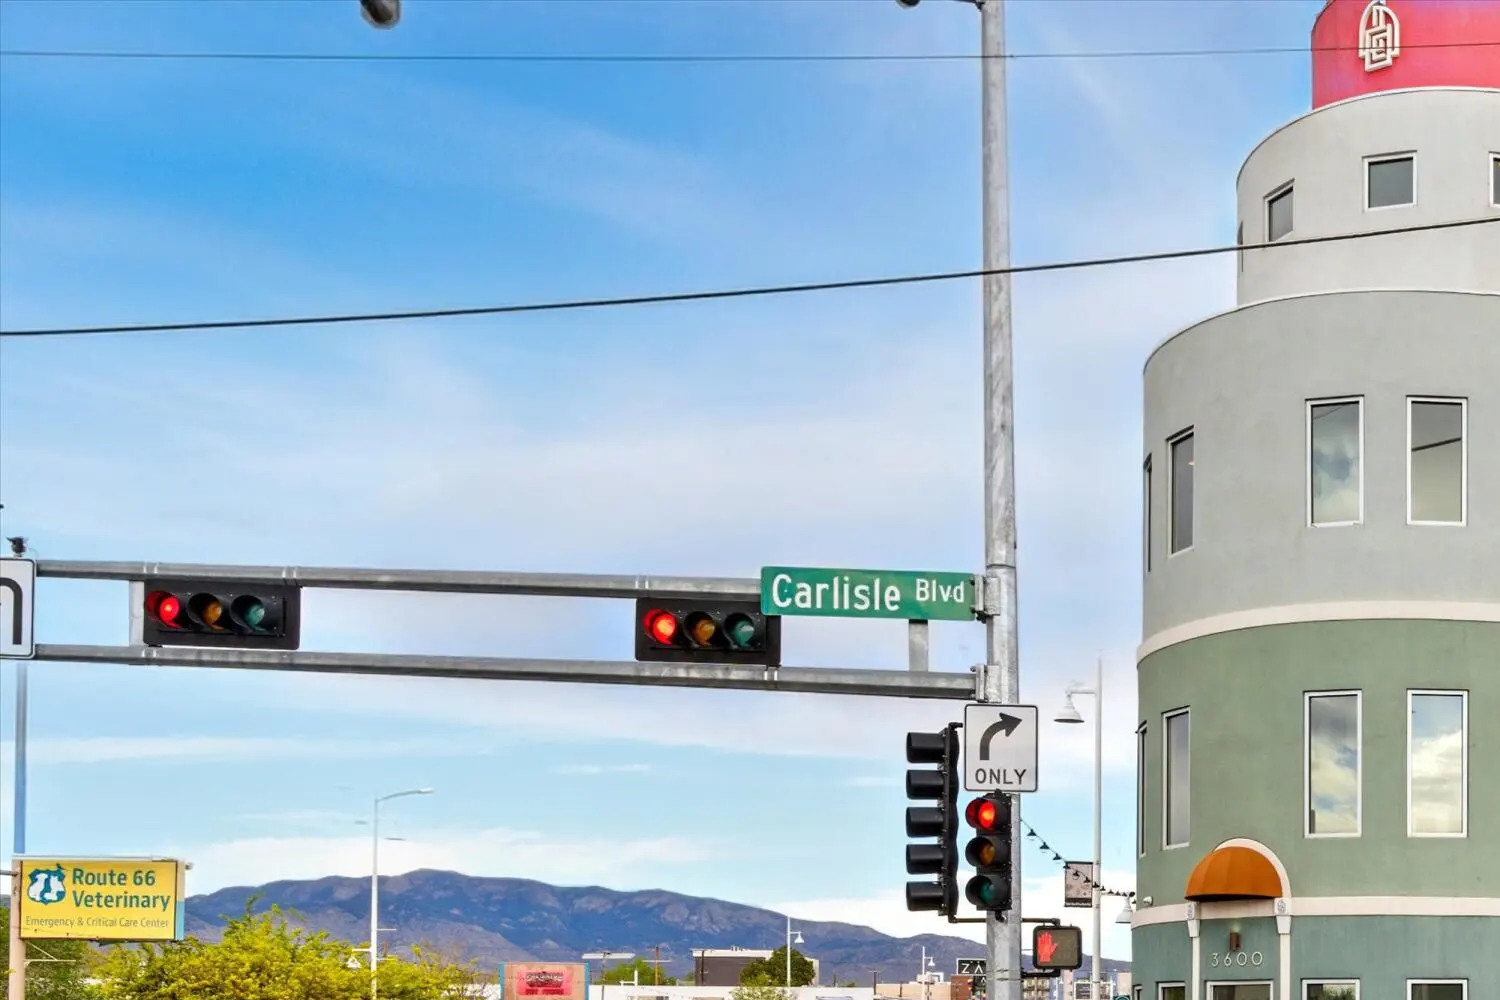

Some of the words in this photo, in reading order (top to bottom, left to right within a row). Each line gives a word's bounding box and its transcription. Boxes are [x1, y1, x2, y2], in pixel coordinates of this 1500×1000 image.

[772, 574, 901, 611] Carlisle
[915, 578, 965, 604] Blvd
[975, 768, 1027, 785] ONLY
[73, 868, 127, 886] Route
[133, 870, 156, 886] 66
[73, 891, 170, 912] Veterinary
[26, 916, 75, 928] Emergency
[77, 917, 84, 926] &
[86, 917, 117, 927] Critical
[119, 917, 139, 927] Care
[140, 917, 169, 928] Center
[1212, 952, 1263, 967] 3600
